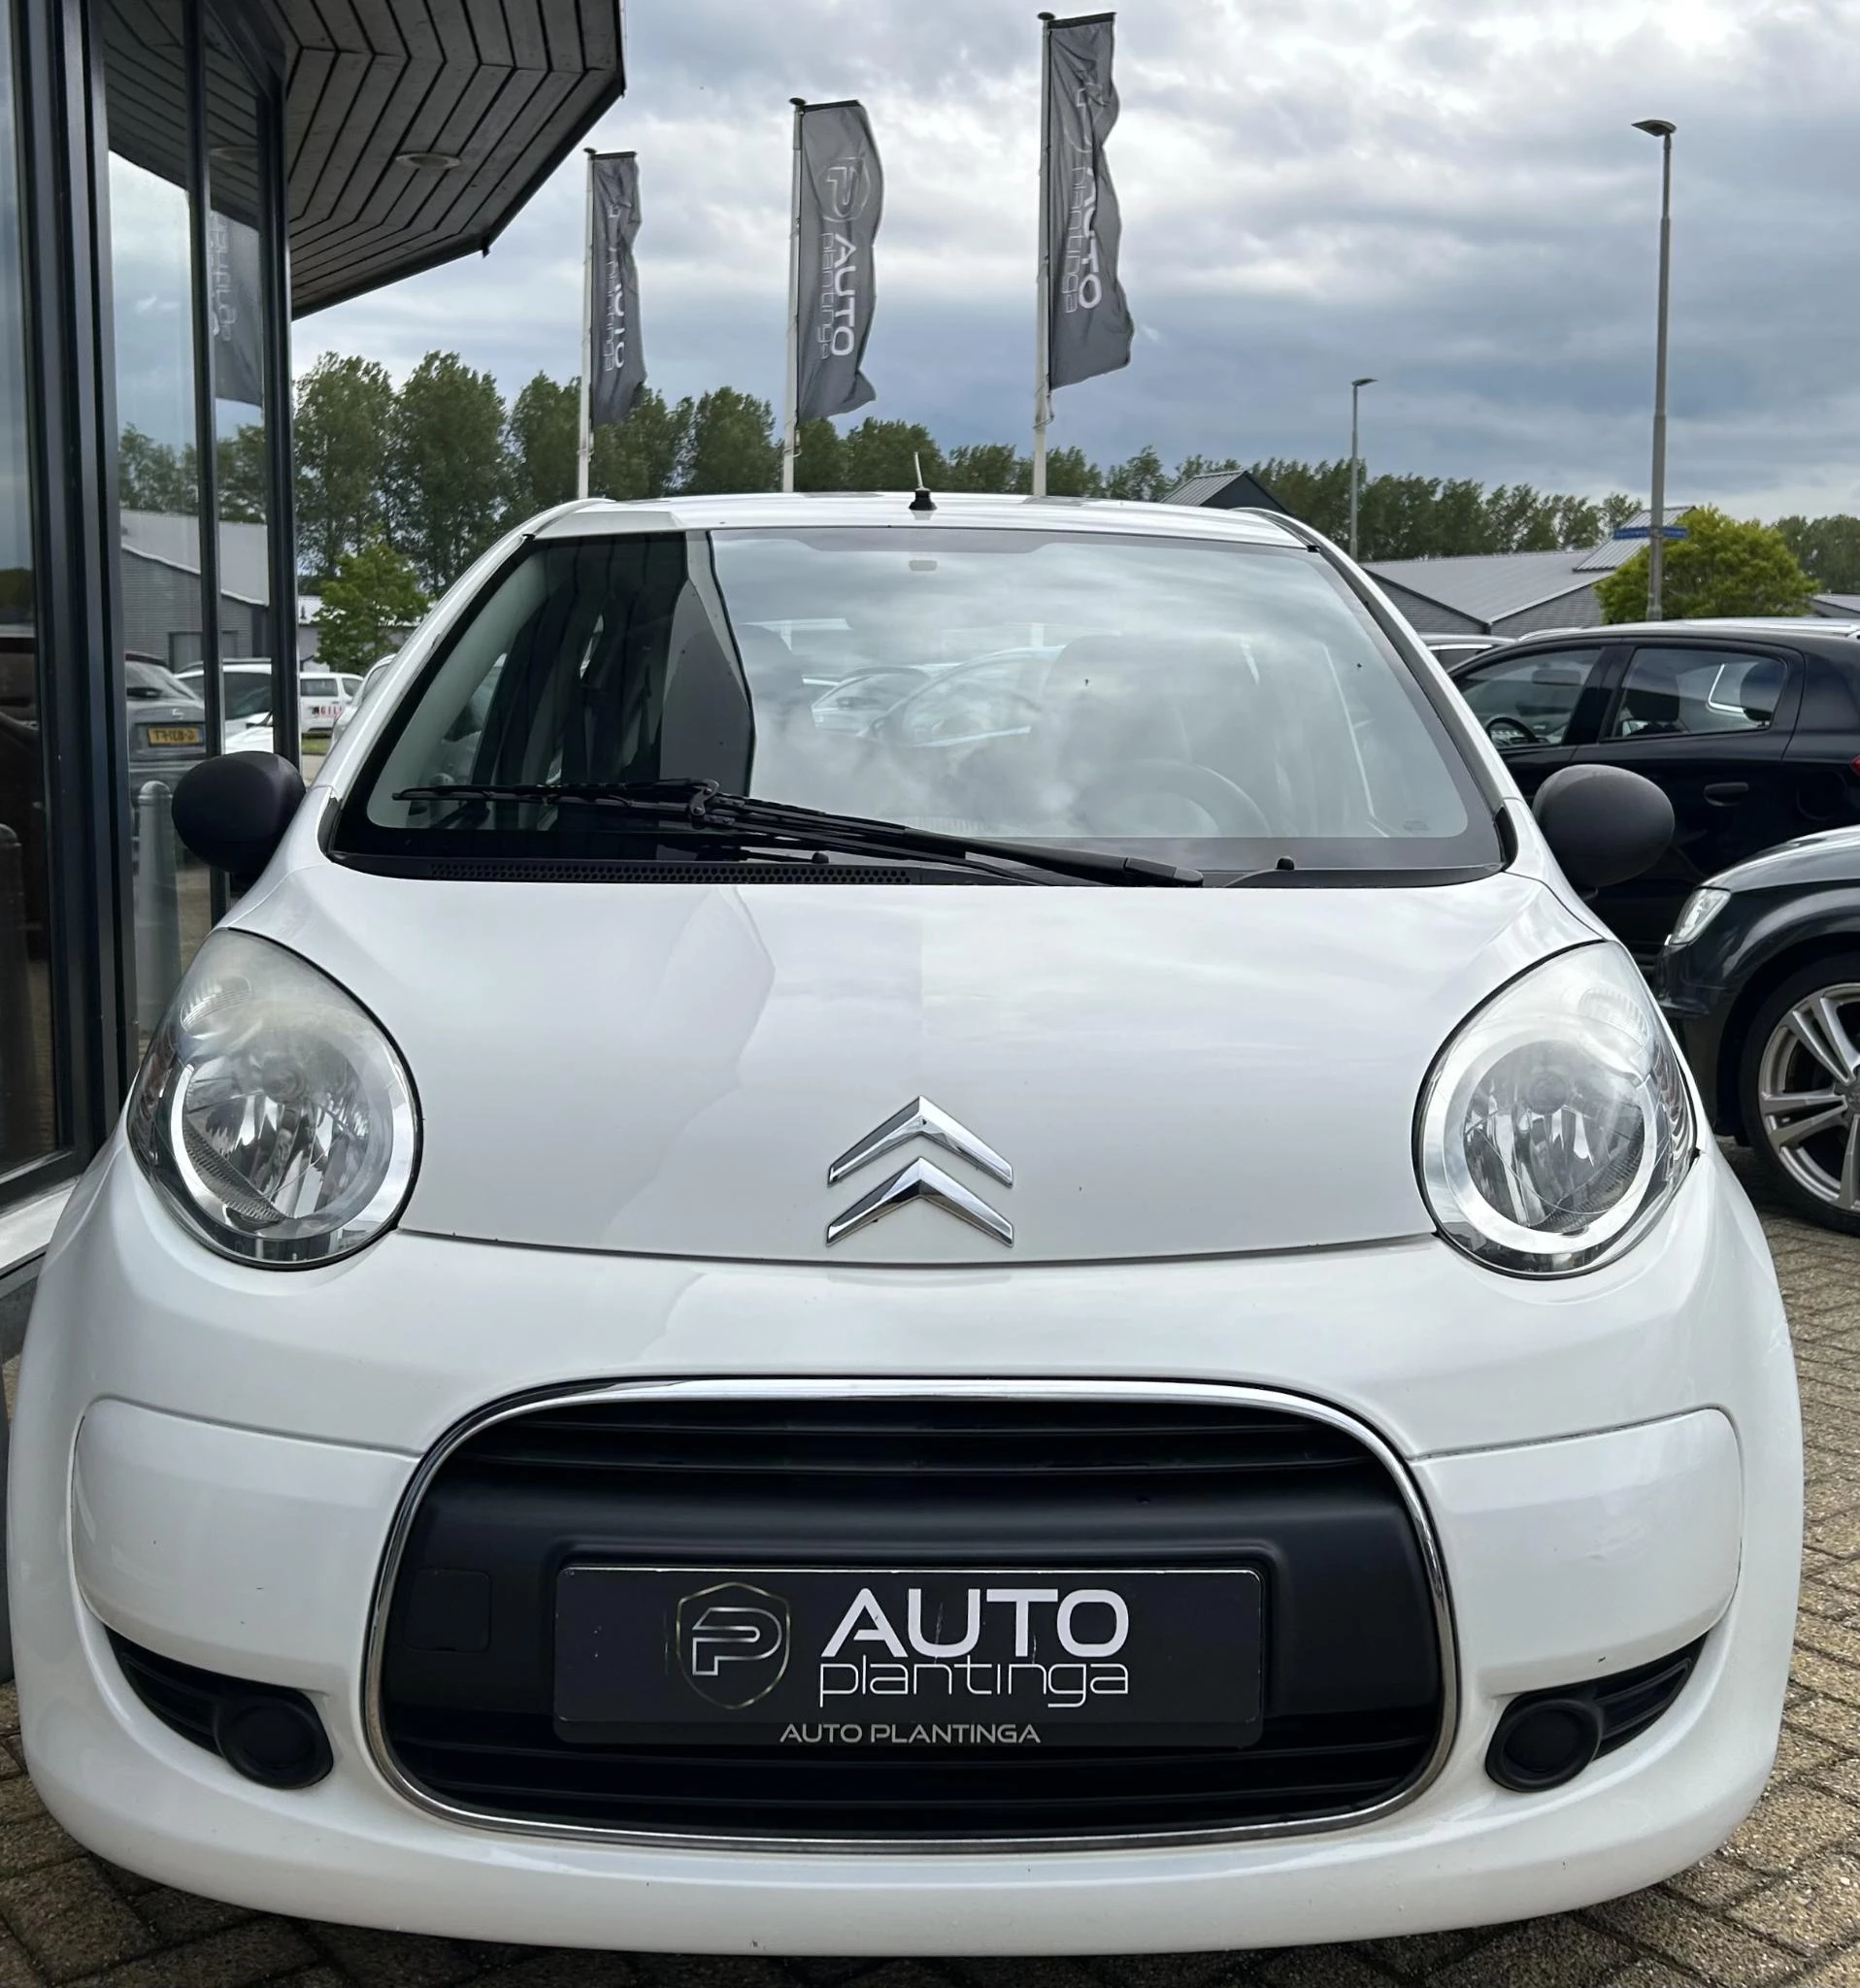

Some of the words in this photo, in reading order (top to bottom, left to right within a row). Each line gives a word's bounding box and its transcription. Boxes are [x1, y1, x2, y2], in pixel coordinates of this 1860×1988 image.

[817, 232, 836, 360] plantinga
[832, 232, 856, 356] AUTO
[820, 1587, 1129, 1658] AUTO
[819, 1654, 1129, 1708] plantinga
[780, 1723, 863, 1743] AUTO
[870, 1723, 1042, 1744] PLANTINGA
